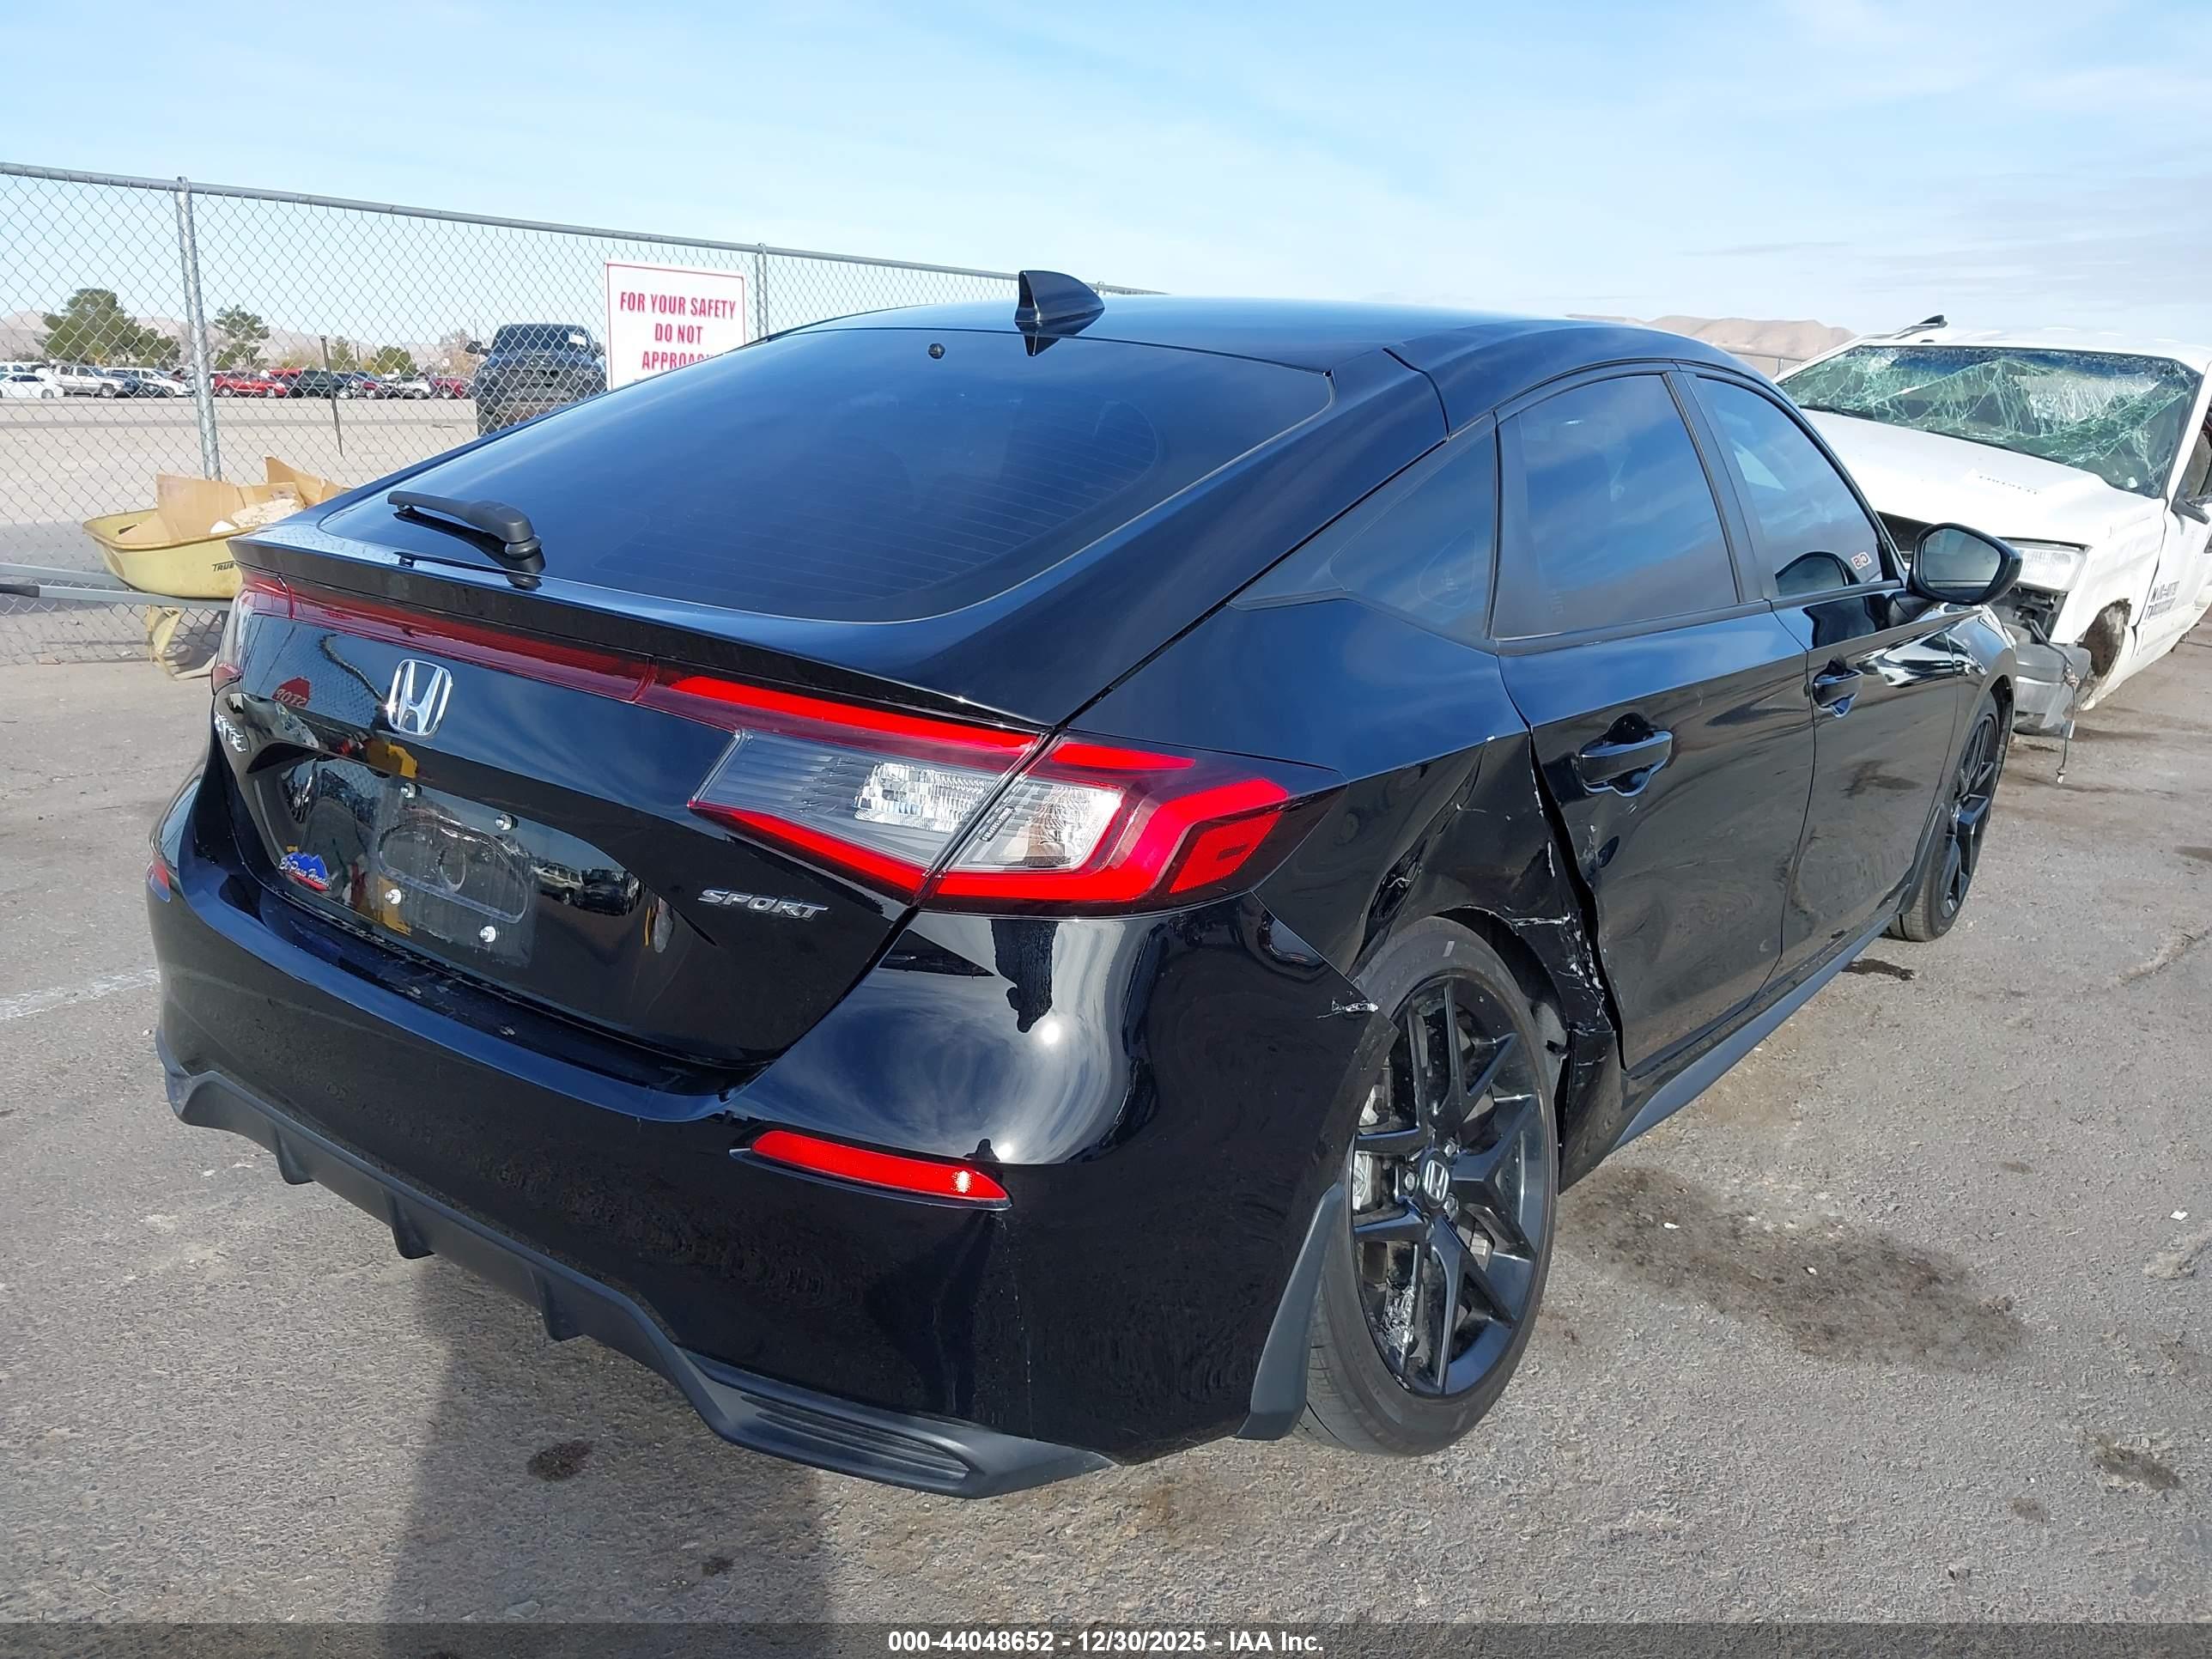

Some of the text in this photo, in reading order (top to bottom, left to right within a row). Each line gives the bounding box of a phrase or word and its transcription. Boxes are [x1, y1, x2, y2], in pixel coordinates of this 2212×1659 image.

[620, 292, 737, 319] FOR YOUR SAFETY
[655, 323, 703, 344] DO NOT
[641, 351, 714, 370] APPROA
[697, 889, 830, 920] SPORT
